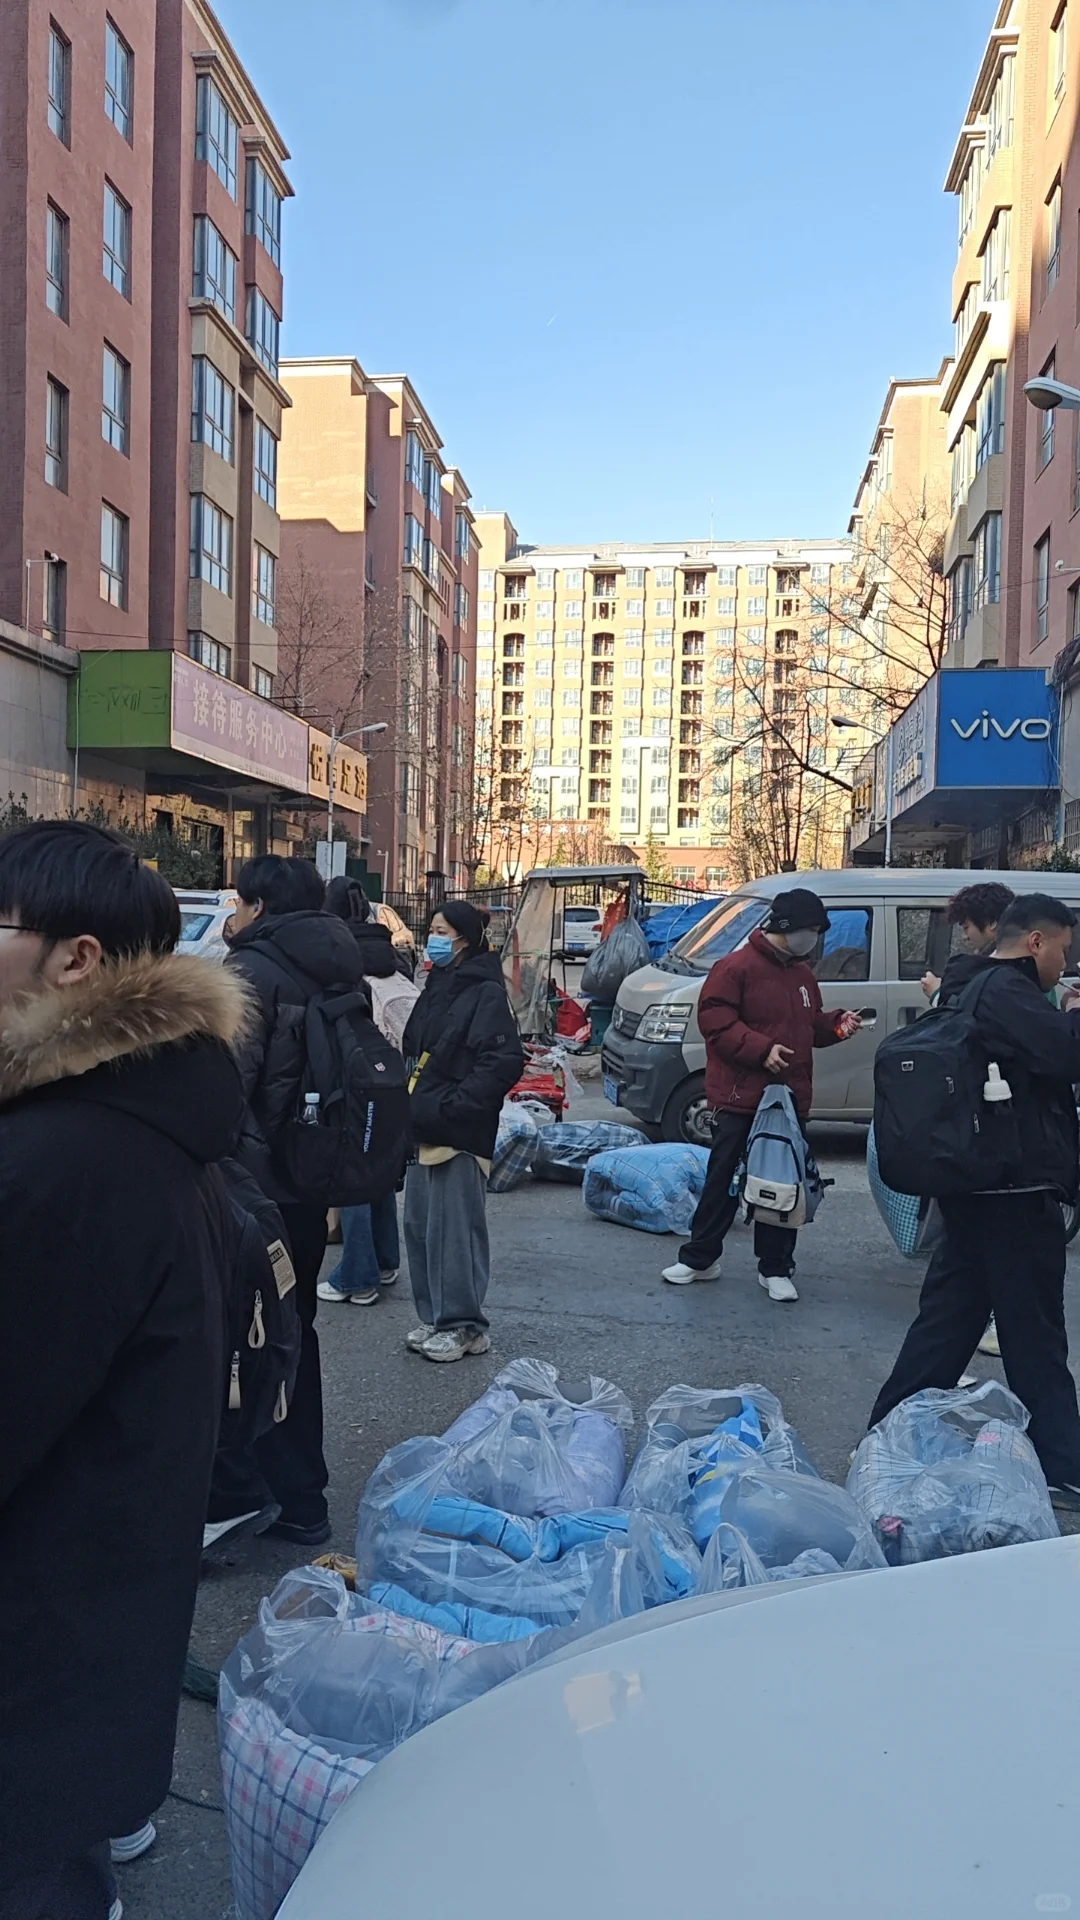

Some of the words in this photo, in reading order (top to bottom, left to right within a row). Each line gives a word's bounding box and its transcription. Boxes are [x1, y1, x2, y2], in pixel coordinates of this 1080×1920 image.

[193, 680, 287, 759] 接待服务中心
[950, 710, 1051, 739] vivo
[366, 1101, 374, 1126] MASTER
